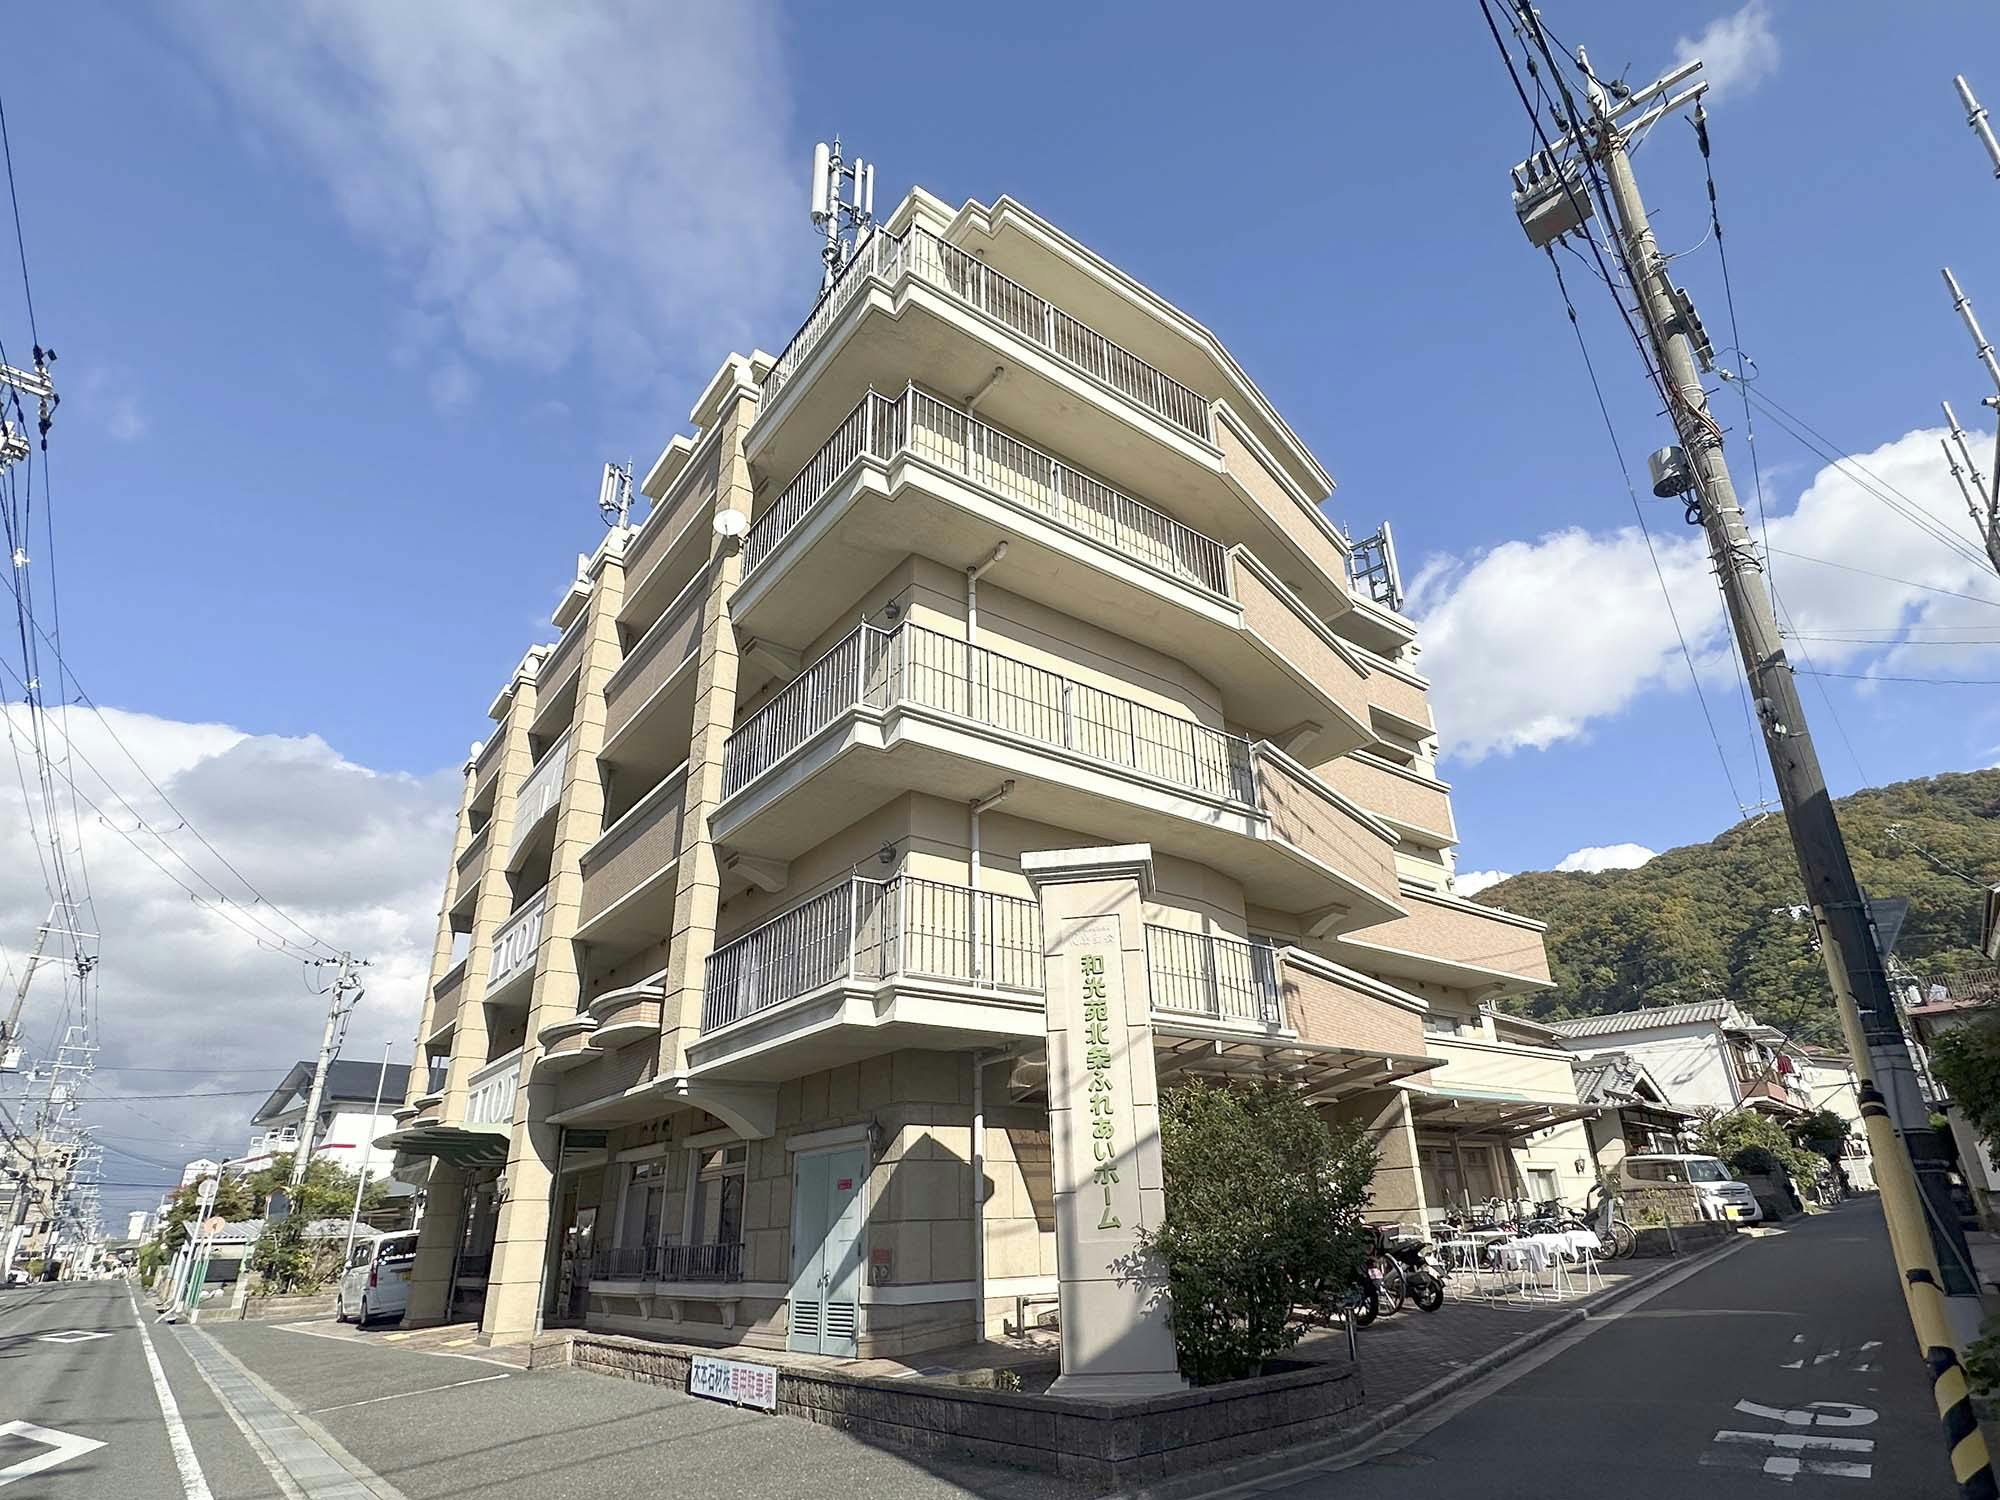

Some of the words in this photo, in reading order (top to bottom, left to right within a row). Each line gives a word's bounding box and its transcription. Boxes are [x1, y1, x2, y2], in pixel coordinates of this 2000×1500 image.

[1080, 953, 1122, 1231] 和光苑北条ふれあいホーム
